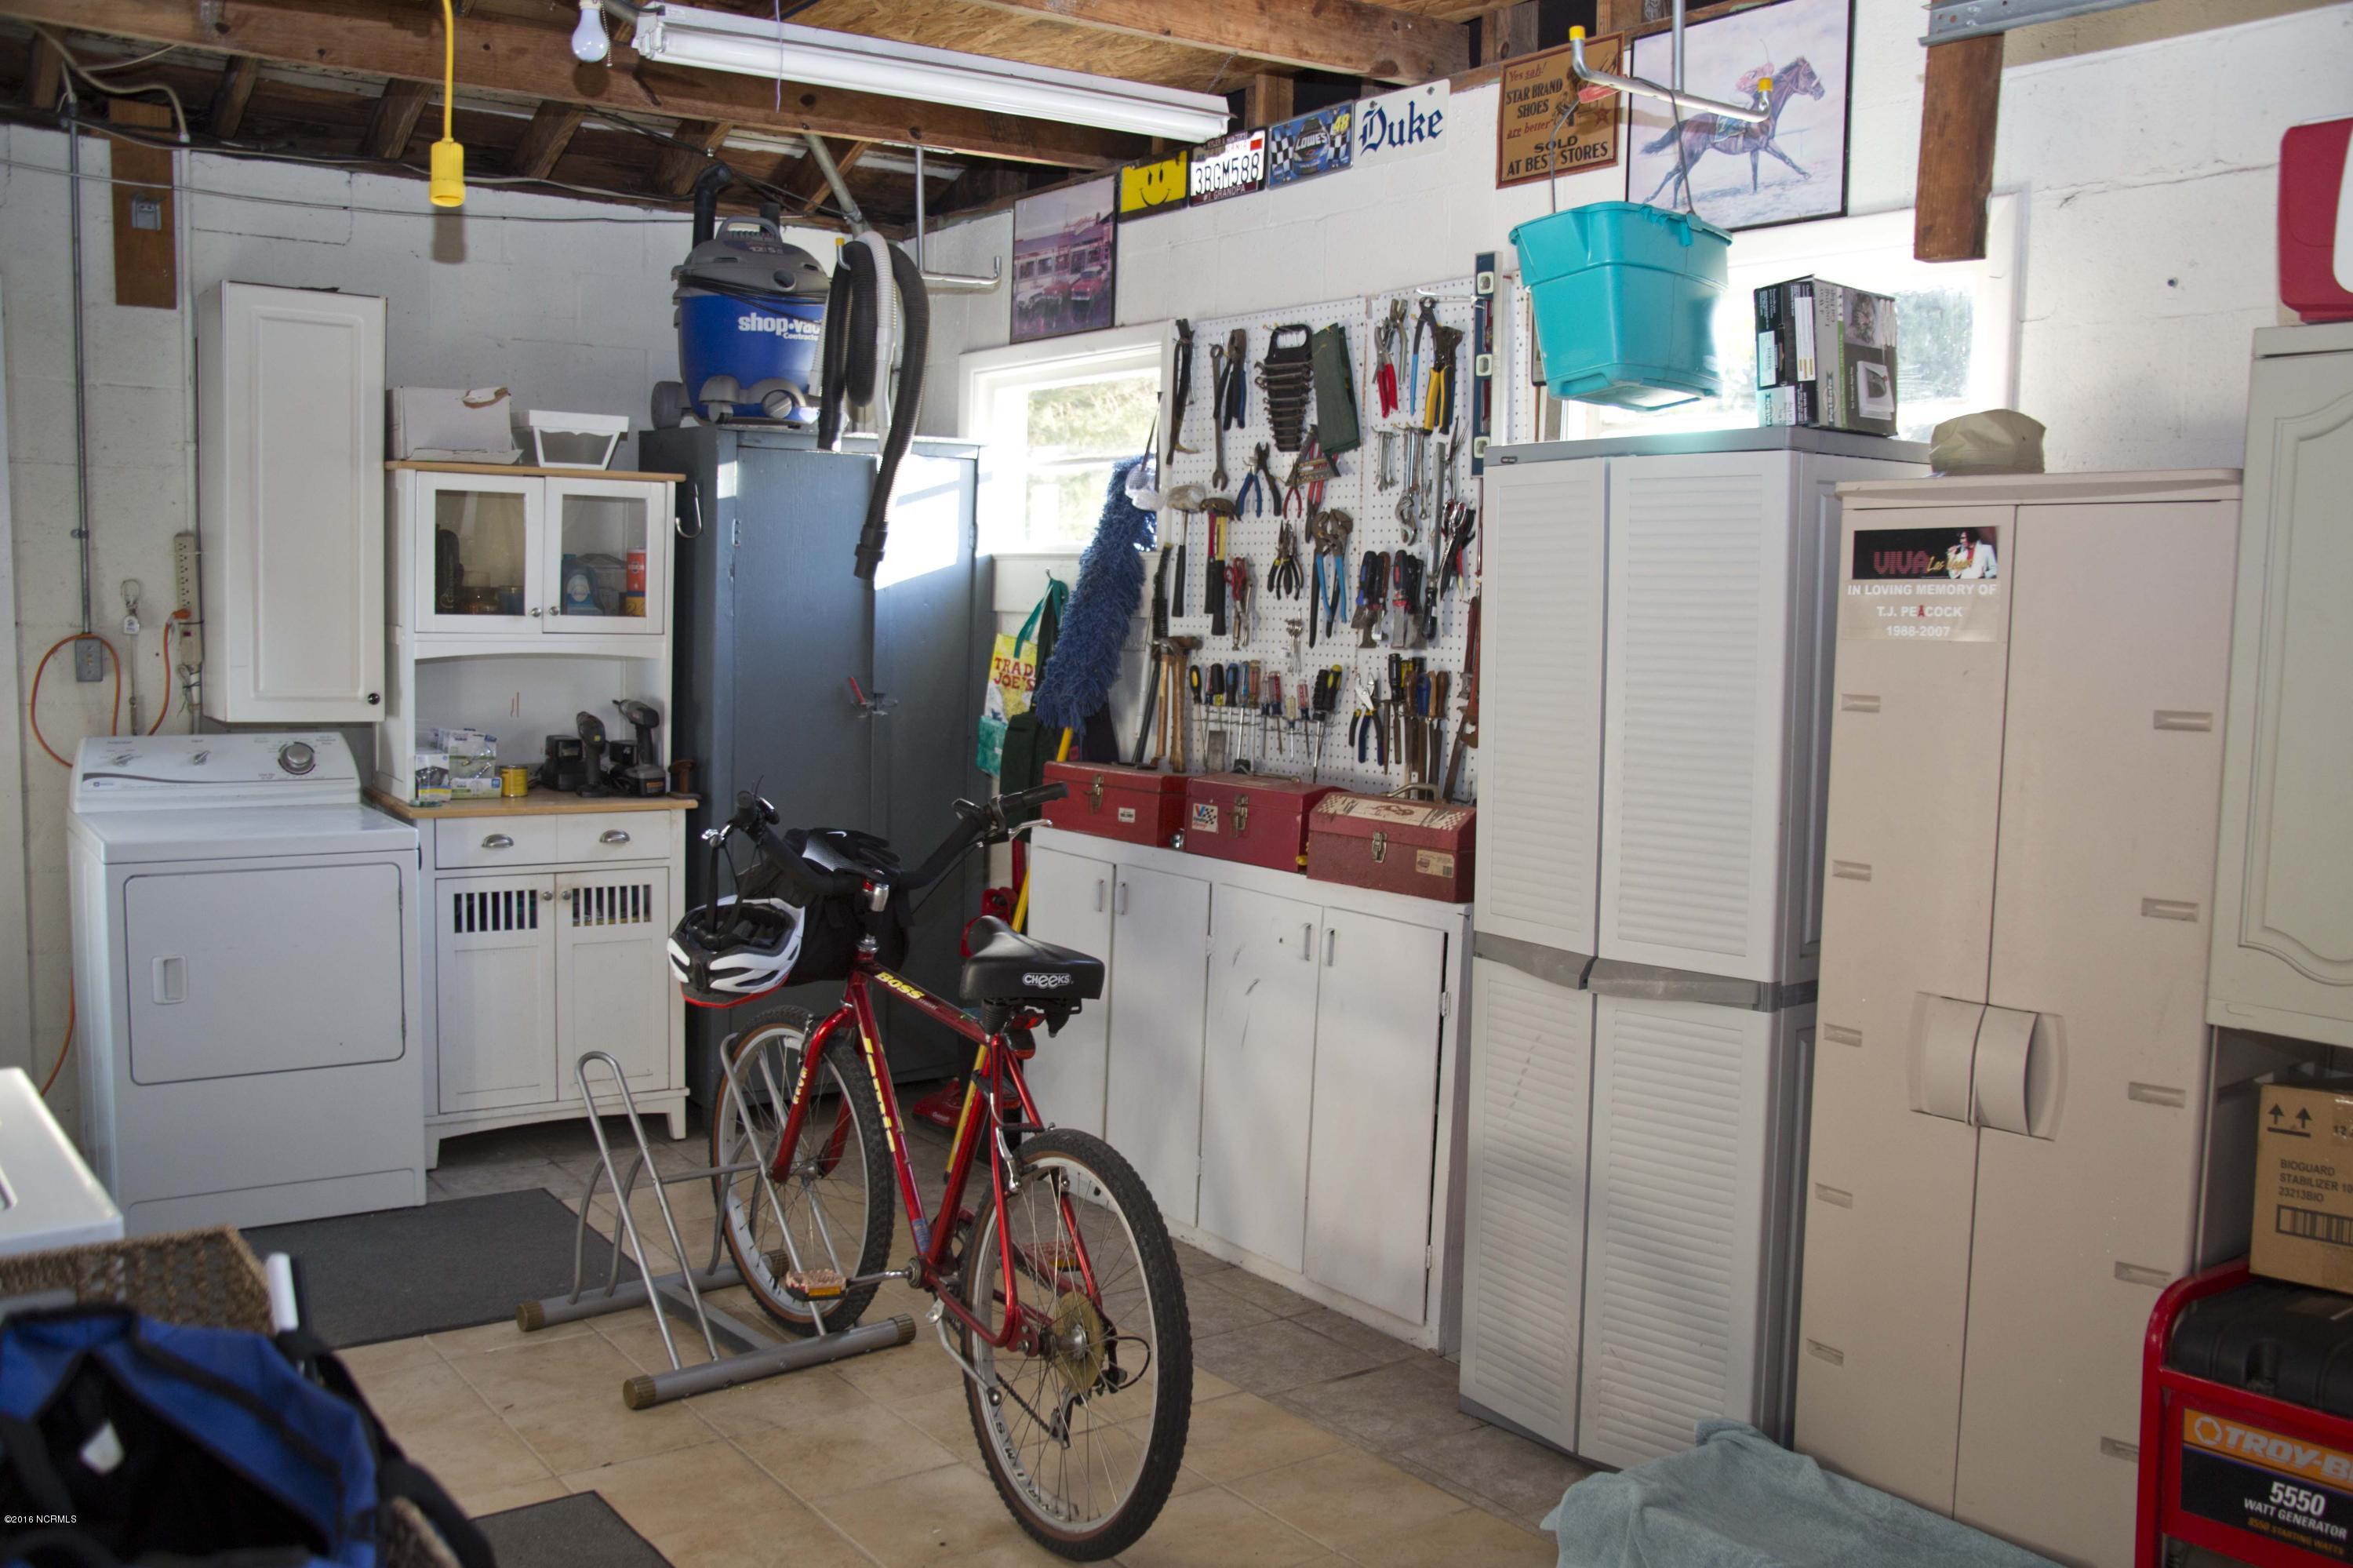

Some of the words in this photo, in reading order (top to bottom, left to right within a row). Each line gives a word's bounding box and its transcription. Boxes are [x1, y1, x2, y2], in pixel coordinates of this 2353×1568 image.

[1506, 88, 1529, 104] STAR
[1533, 78, 1563, 98] BRAND
[1518, 99, 1549, 118] SHOES
[1333, 114, 1350, 133] 48
[1358, 100, 1443, 155] Duke
[1507, 127, 1521, 140] are
[1534, 136, 1578, 153] SOLD
[1507, 159, 1522, 176] AT
[1561, 142, 1608, 164] STORES
[1195, 152, 1260, 195] 3BGM588
[1214, 184, 1246, 200] GRANDPA
[1874, 551, 1929, 574] VIVA
[1926, 556, 1945, 573] Las
[1847, 585, 1861, 595] IN
[1864, 584, 1911, 595] LOVING
[1915, 584, 1974, 595] MEMORY
[1978, 584, 1997, 595] OF
[1876, 606, 1897, 617] T.J.
[1900, 605, 1962, 617] PEACOCK
[1886, 626, 1951, 637] 1988-2007
[995, 657, 1036, 676] TRAD
[994, 671, 1036, 691] JOE'S
[875, 972, 925, 999] BOSS
[2280, 1159, 2335, 1176] BIOGUARD
[2279, 1173, 2339, 1191] STABILIZER
[2278, 1186, 2324, 1202] 23213BIO
[2269, 1481, 2326, 1517] 5550
[2244, 1497, 2276, 1517] WATT
[2278, 1508, 2348, 1540] GENERATOR
